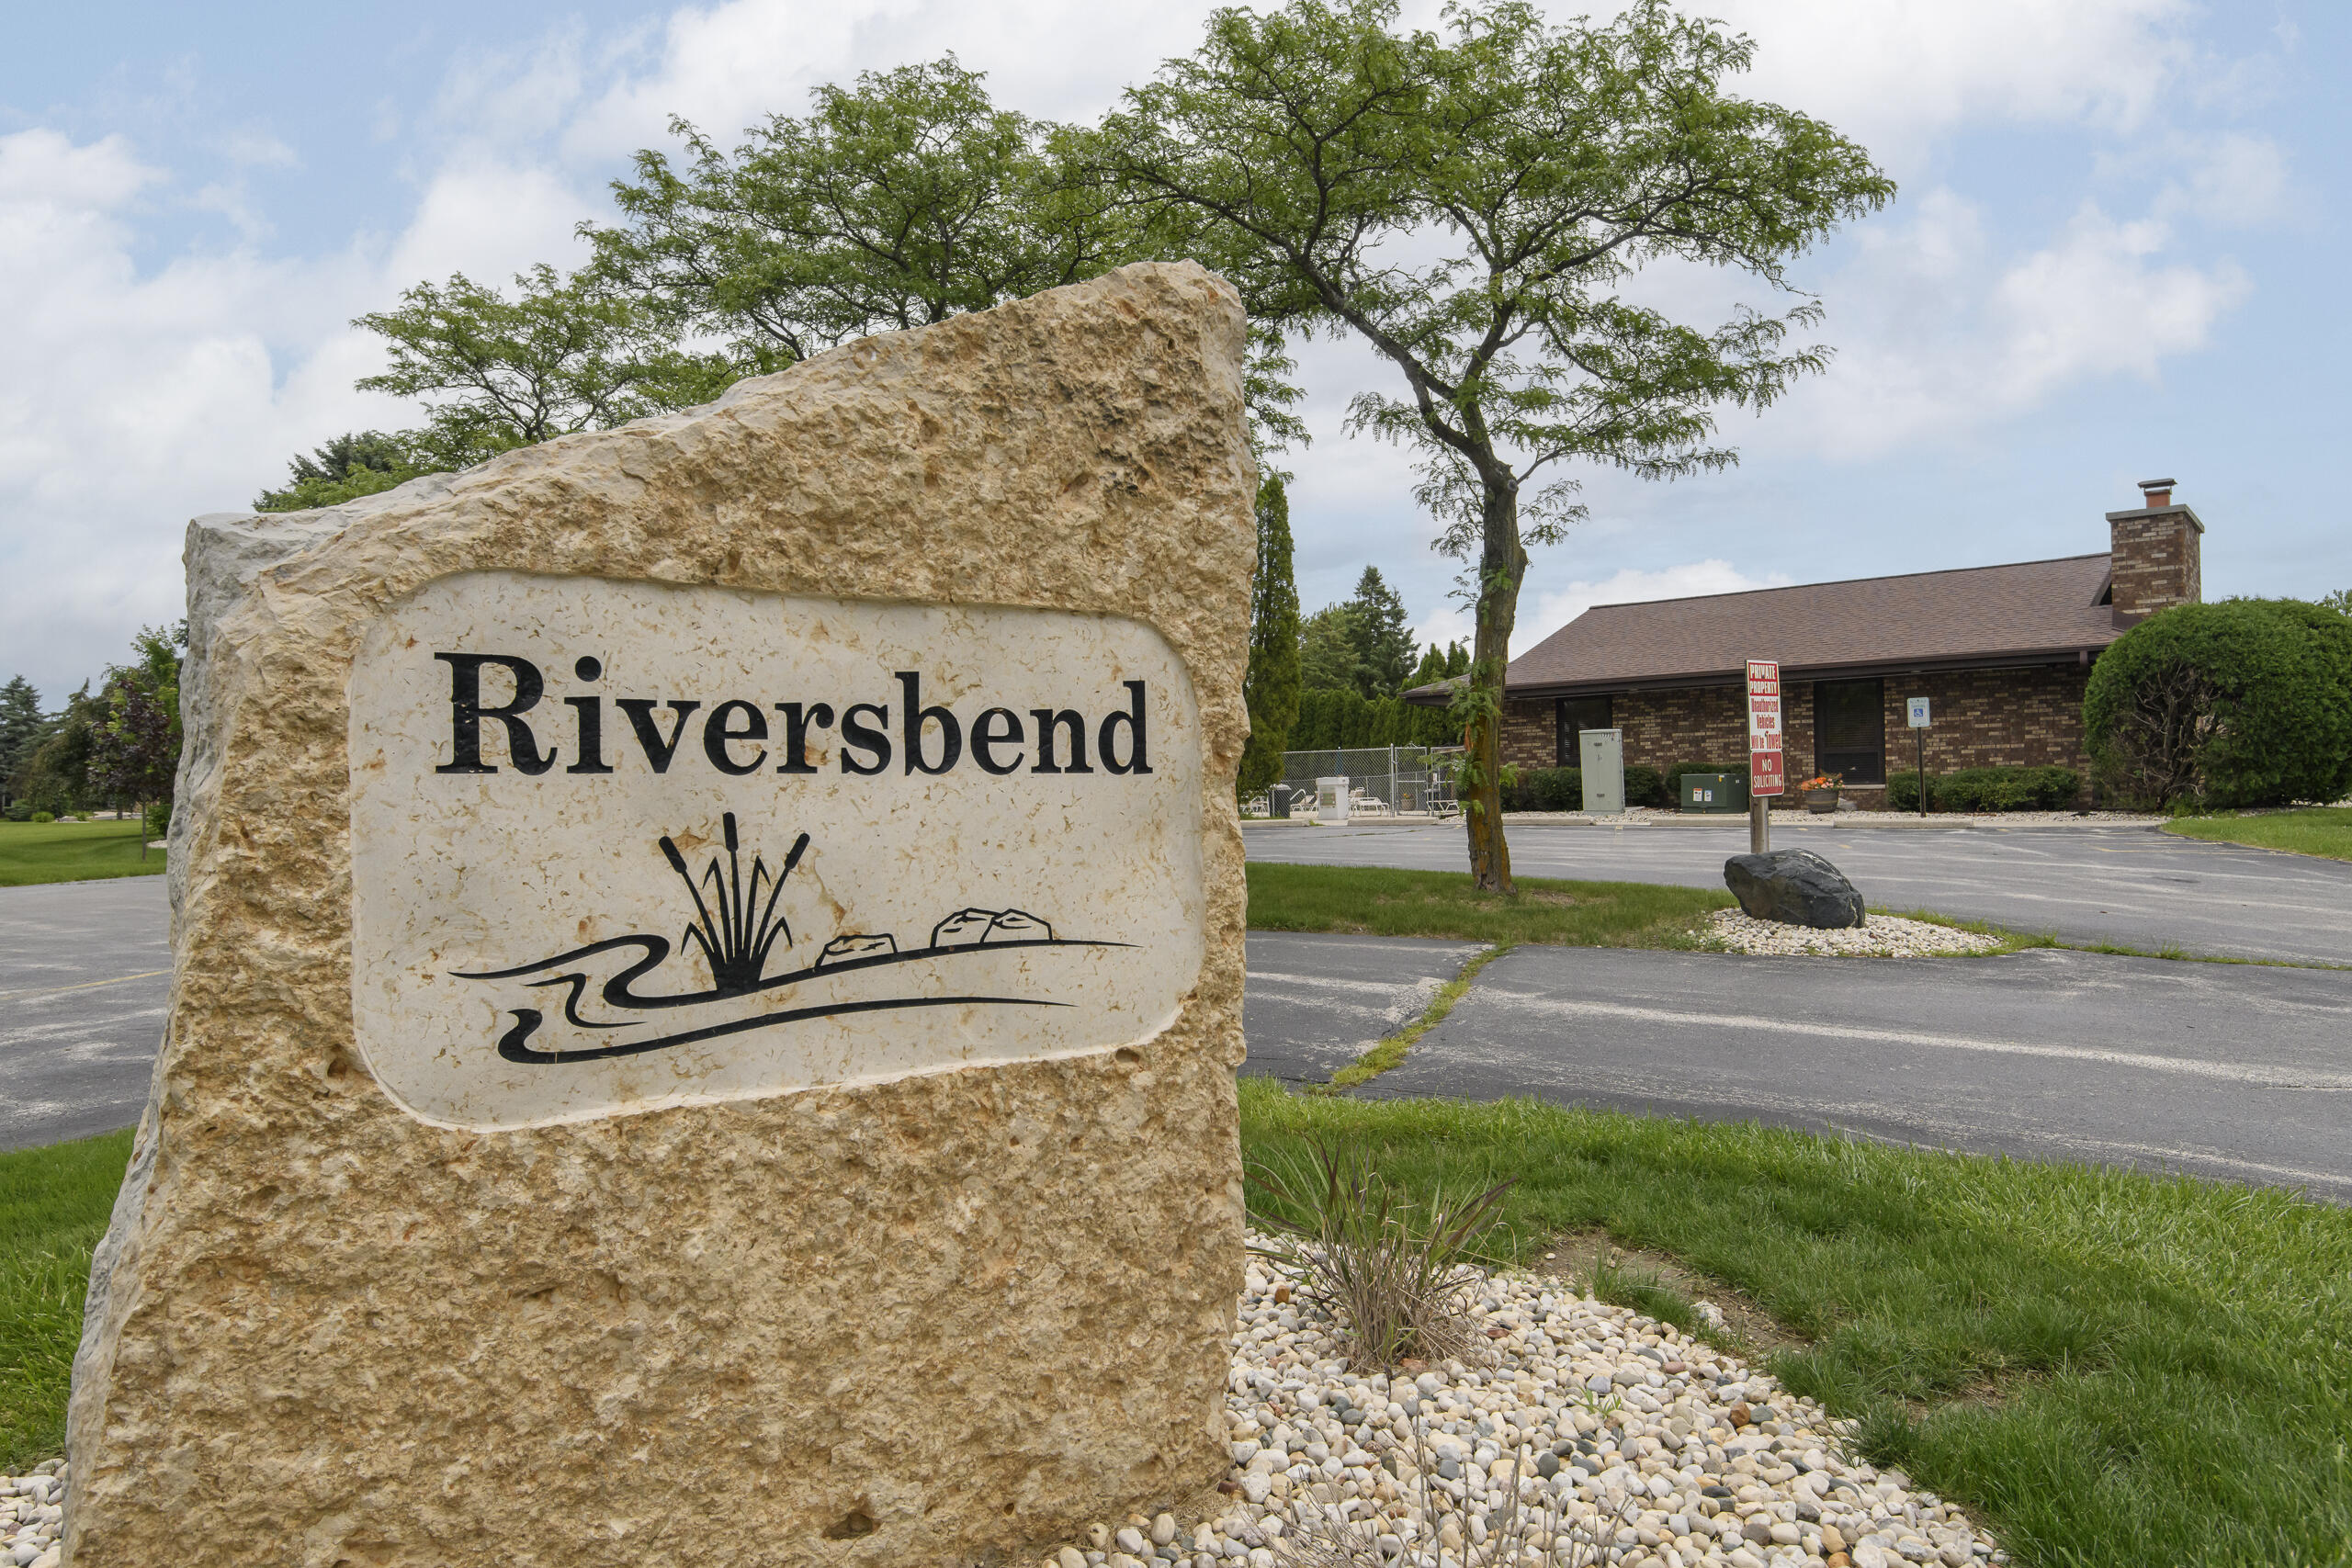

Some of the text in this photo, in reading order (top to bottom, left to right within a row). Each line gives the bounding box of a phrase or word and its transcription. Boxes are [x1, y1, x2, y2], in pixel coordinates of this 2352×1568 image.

[1750, 664, 1776, 680] PRIVATE
[1749, 681, 1777, 694] PROPERTY
[1751, 698, 1779, 713] Unauthorized
[434, 651, 1153, 776] Riversbend
[1757, 714, 1775, 729] Vehicles
[1762, 759, 1771, 772] NO
[1754, 773, 1781, 788] SOLICITING
